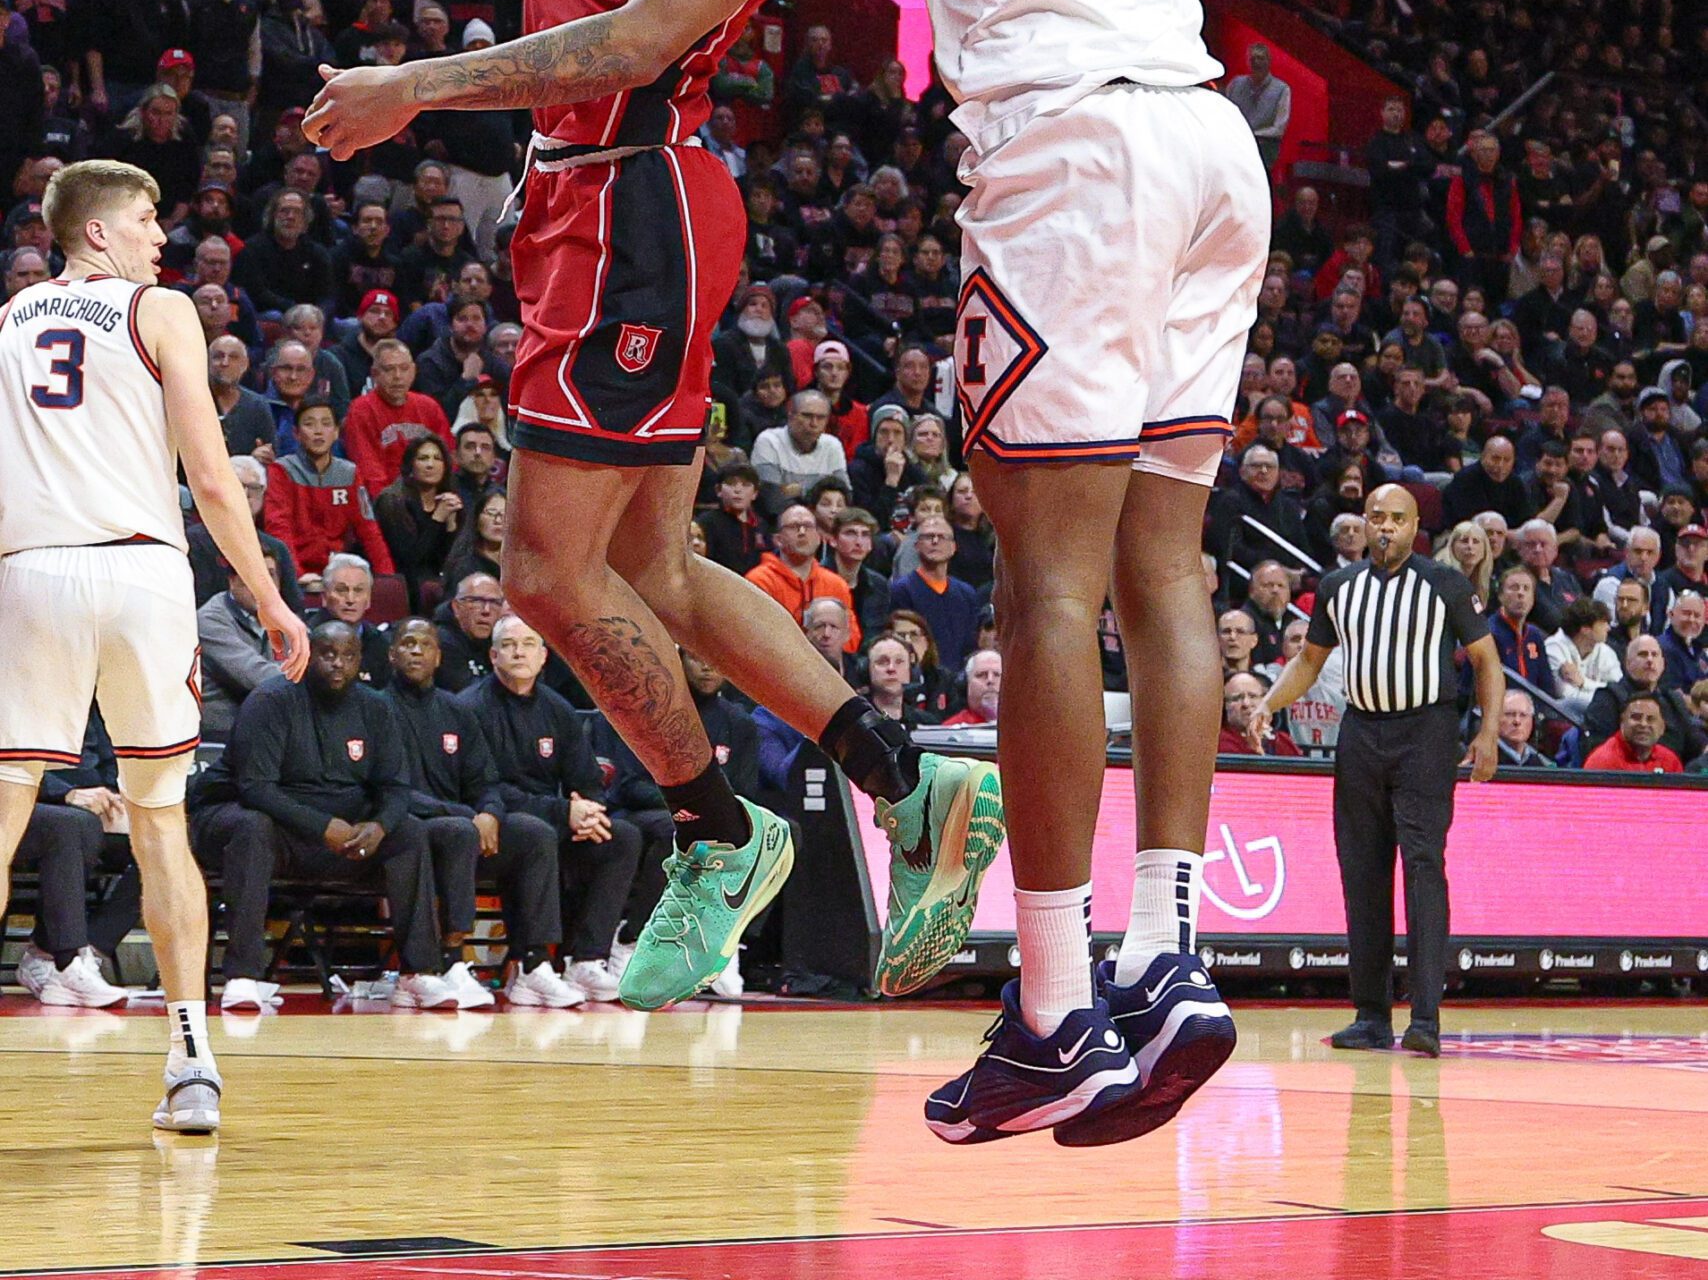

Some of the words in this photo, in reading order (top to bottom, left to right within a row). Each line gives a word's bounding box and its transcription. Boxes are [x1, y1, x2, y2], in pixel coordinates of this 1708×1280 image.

[12, 297, 122, 333] HUMRICHOUS
[622, 331, 648, 364] R
[963, 315, 987, 386] I
[30, 328, 86, 410] 3
[332, 488, 349, 505] R
[1216, 952, 1261, 966] Prudential
[1306, 952, 1350, 967] Prudential
[1474, 953, 1516, 967] Prudential
[1554, 954, 1594, 968] Prudential
[1634, 954, 1673, 968] Prudential
